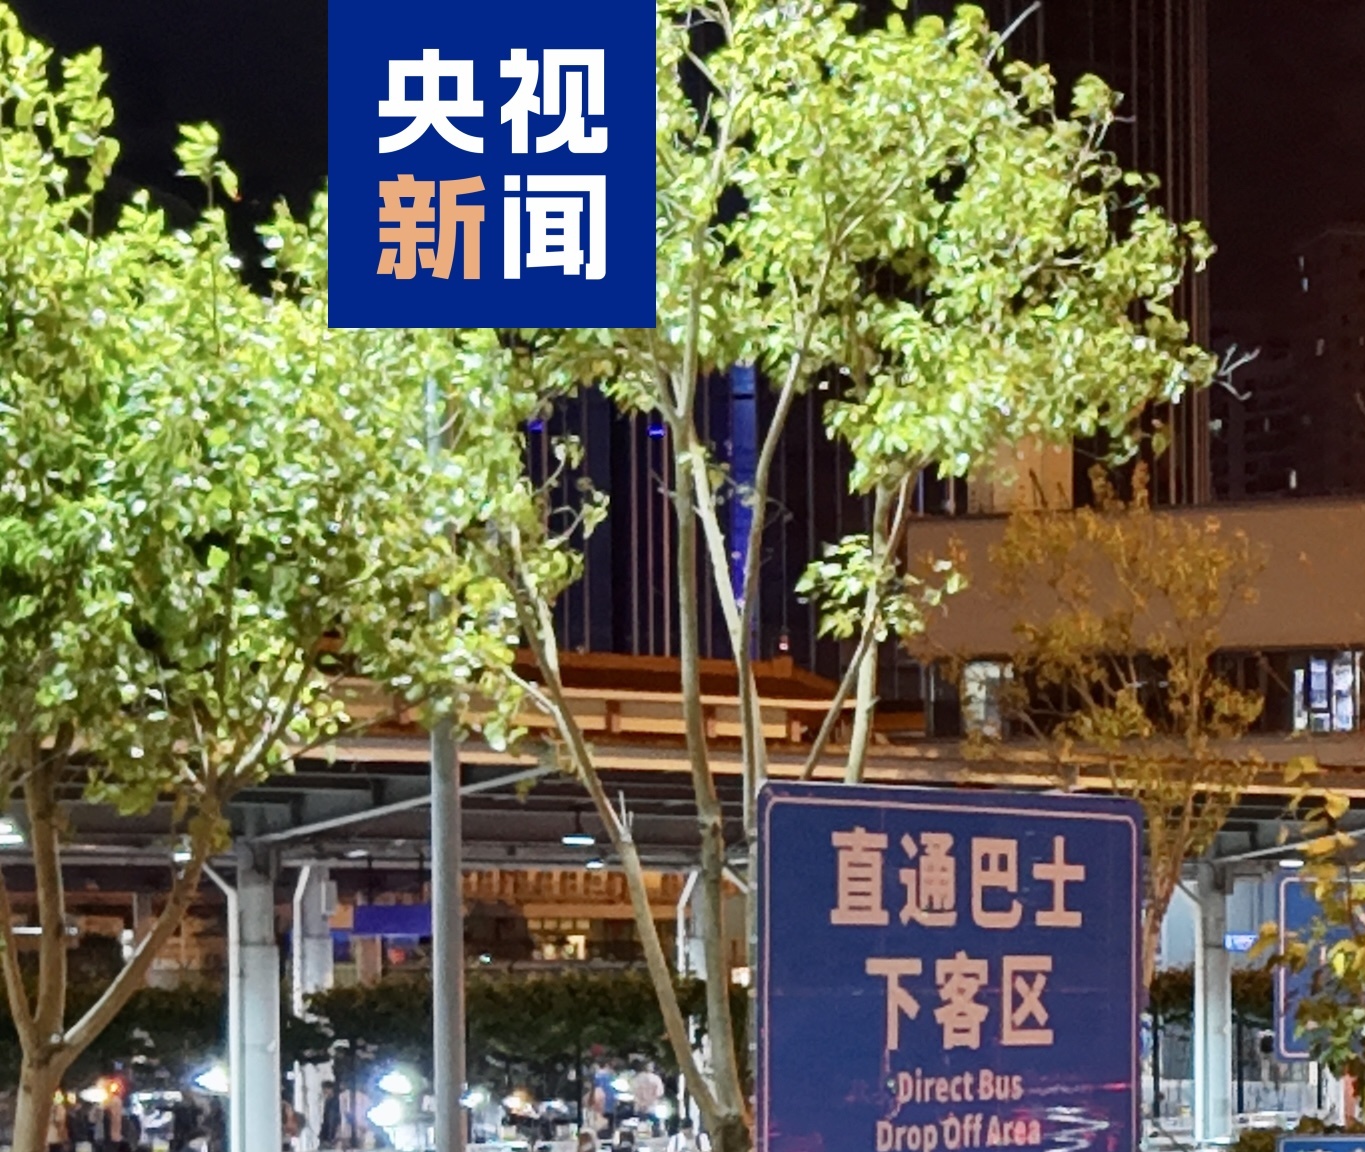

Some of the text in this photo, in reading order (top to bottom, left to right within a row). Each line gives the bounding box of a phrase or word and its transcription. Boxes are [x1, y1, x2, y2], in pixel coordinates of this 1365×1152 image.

[830, 826, 1086, 929] 直通巴士
[865, 950, 1054, 1051] 下客区
[898, 1066, 1025, 1104] Direct Bus
[940, 1112, 984, 1151] Off
[985, 1114, 1042, 1147] Area
